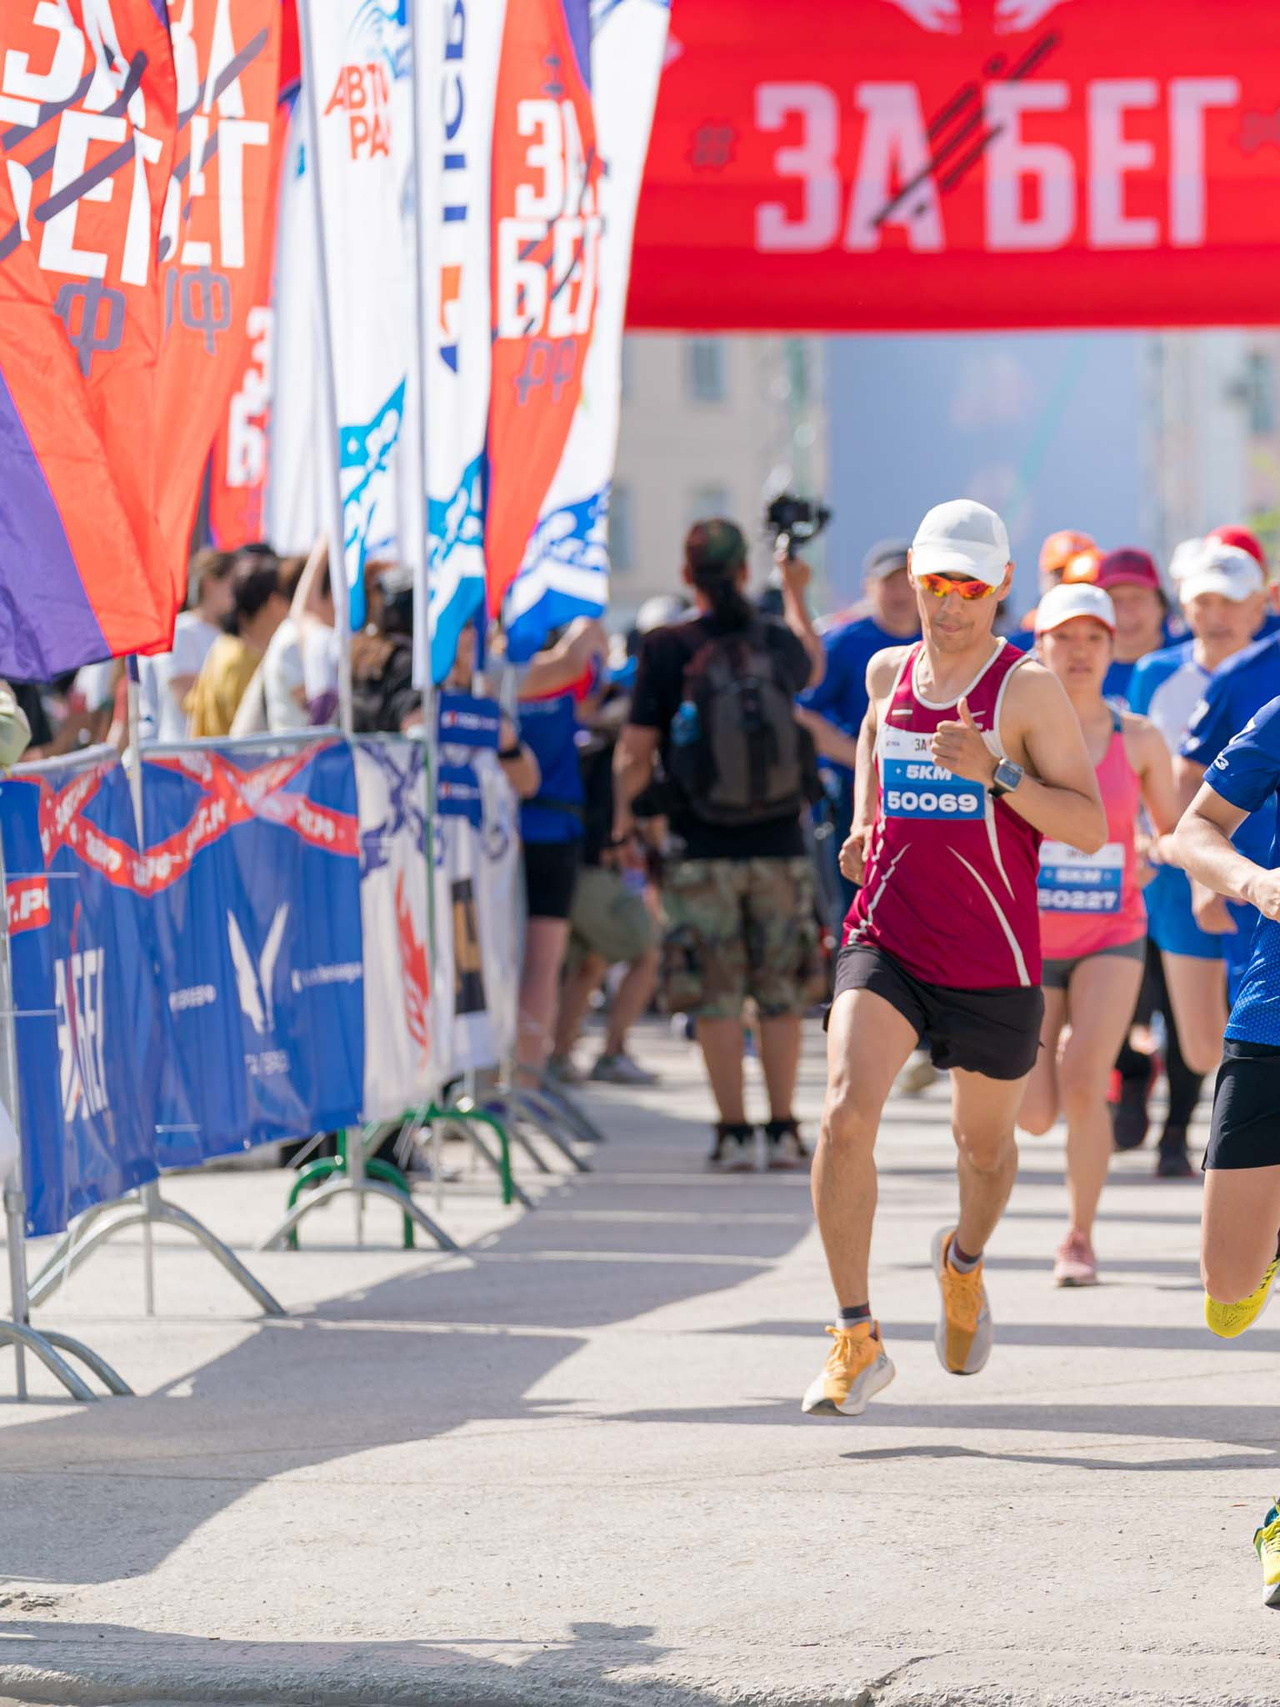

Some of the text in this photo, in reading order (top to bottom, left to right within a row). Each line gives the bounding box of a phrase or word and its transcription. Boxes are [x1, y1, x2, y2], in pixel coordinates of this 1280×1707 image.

[755, 81, 946, 253] ЗА
[985, 75, 1239, 253] БЕГ
[887, 791, 978, 813] 50069
[1037, 888, 1118, 910] 50227
